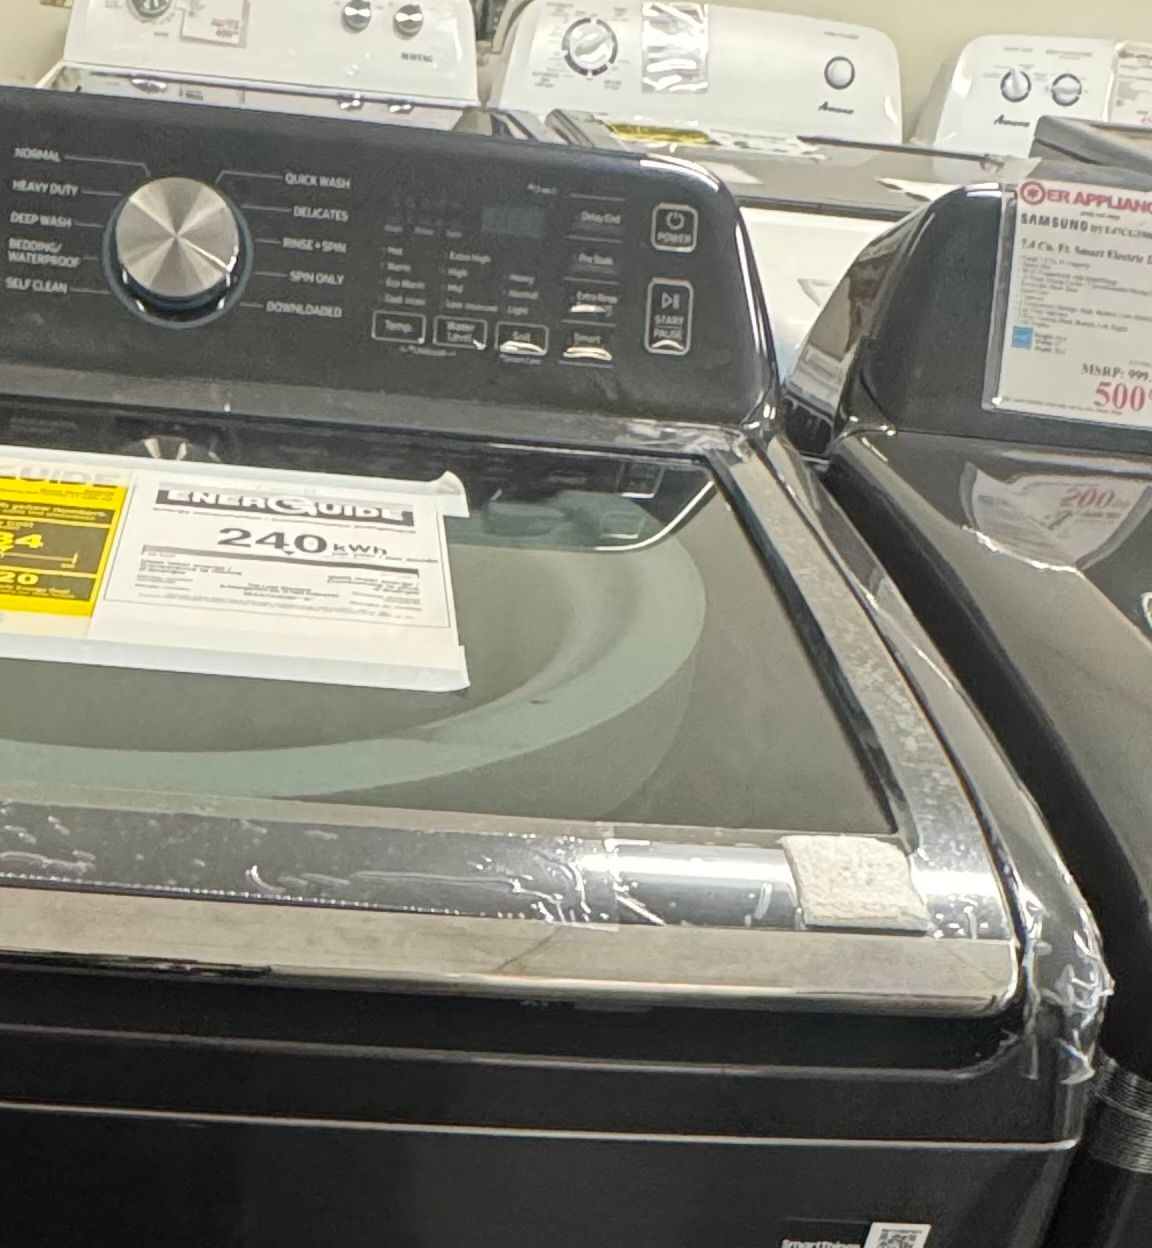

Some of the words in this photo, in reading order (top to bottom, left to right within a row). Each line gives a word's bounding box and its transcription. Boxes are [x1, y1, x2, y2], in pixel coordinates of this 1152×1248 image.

[14, 147, 62, 163] NORMAL
[12, 179, 48, 195] HEAVY
[49, 183, 78, 197] DUTY
[285, 172, 317, 188] QUICK
[319, 174, 350, 190] WASH
[10, 211, 38, 226] DEEP
[39, 213, 72, 228] WASH
[293, 205, 348, 222] DELICATES
[1021, 212, 1088, 233] SAMSUNG
[282, 236, 313, 251] RINSE
[321, 239, 347, 253] SPIN
[657, 231, 691, 244] POWER
[5, 277, 31, 291] SELF
[32, 279, 68, 294] CLEAN
[290, 270, 316, 284] SPIN
[317, 271, 344, 286] ONLY
[266, 300, 343, 318] DOWNLOADED
[655, 315, 684, 325] START
[1082, 362, 1124, 379] MSRP:
[1094, 381, 1145, 412] 500
[217, 527, 328, 555] 240
[332, 542, 388, 556] kWh
